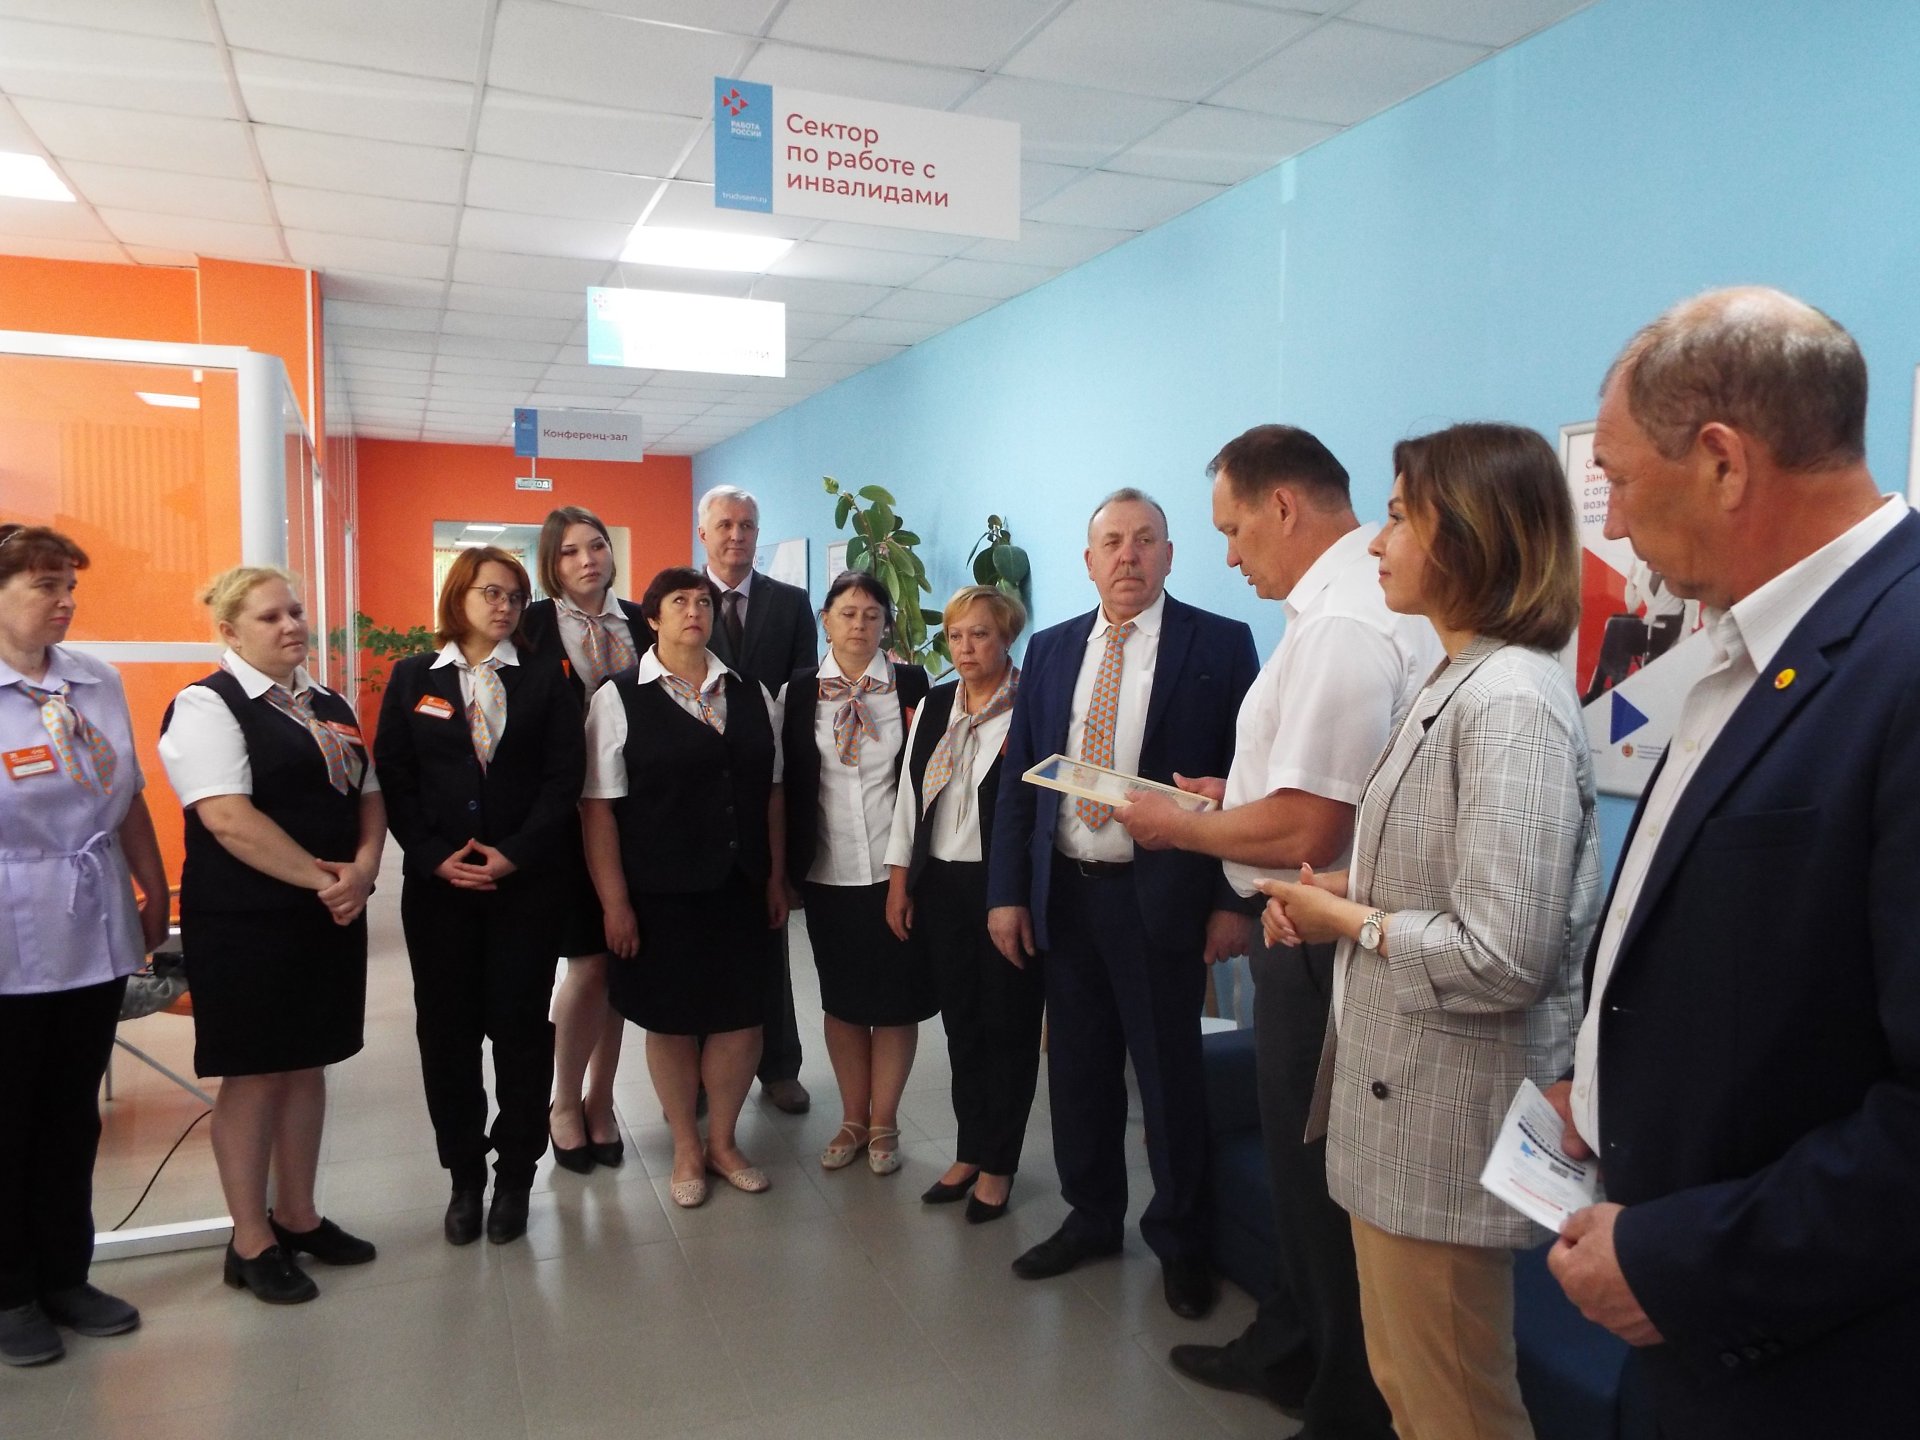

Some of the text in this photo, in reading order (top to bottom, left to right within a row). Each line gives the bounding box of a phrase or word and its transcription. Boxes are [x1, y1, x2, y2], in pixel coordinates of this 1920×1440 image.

[730, 120, 760, 130] РАБОТА
[730, 127, 762, 137] РОССИИ
[786, 114, 880, 147] Сектор
[786, 145, 936, 180] по работе с
[787, 172, 949, 208] инвалидами
[543, 429, 628, 442] Конференц-зал
